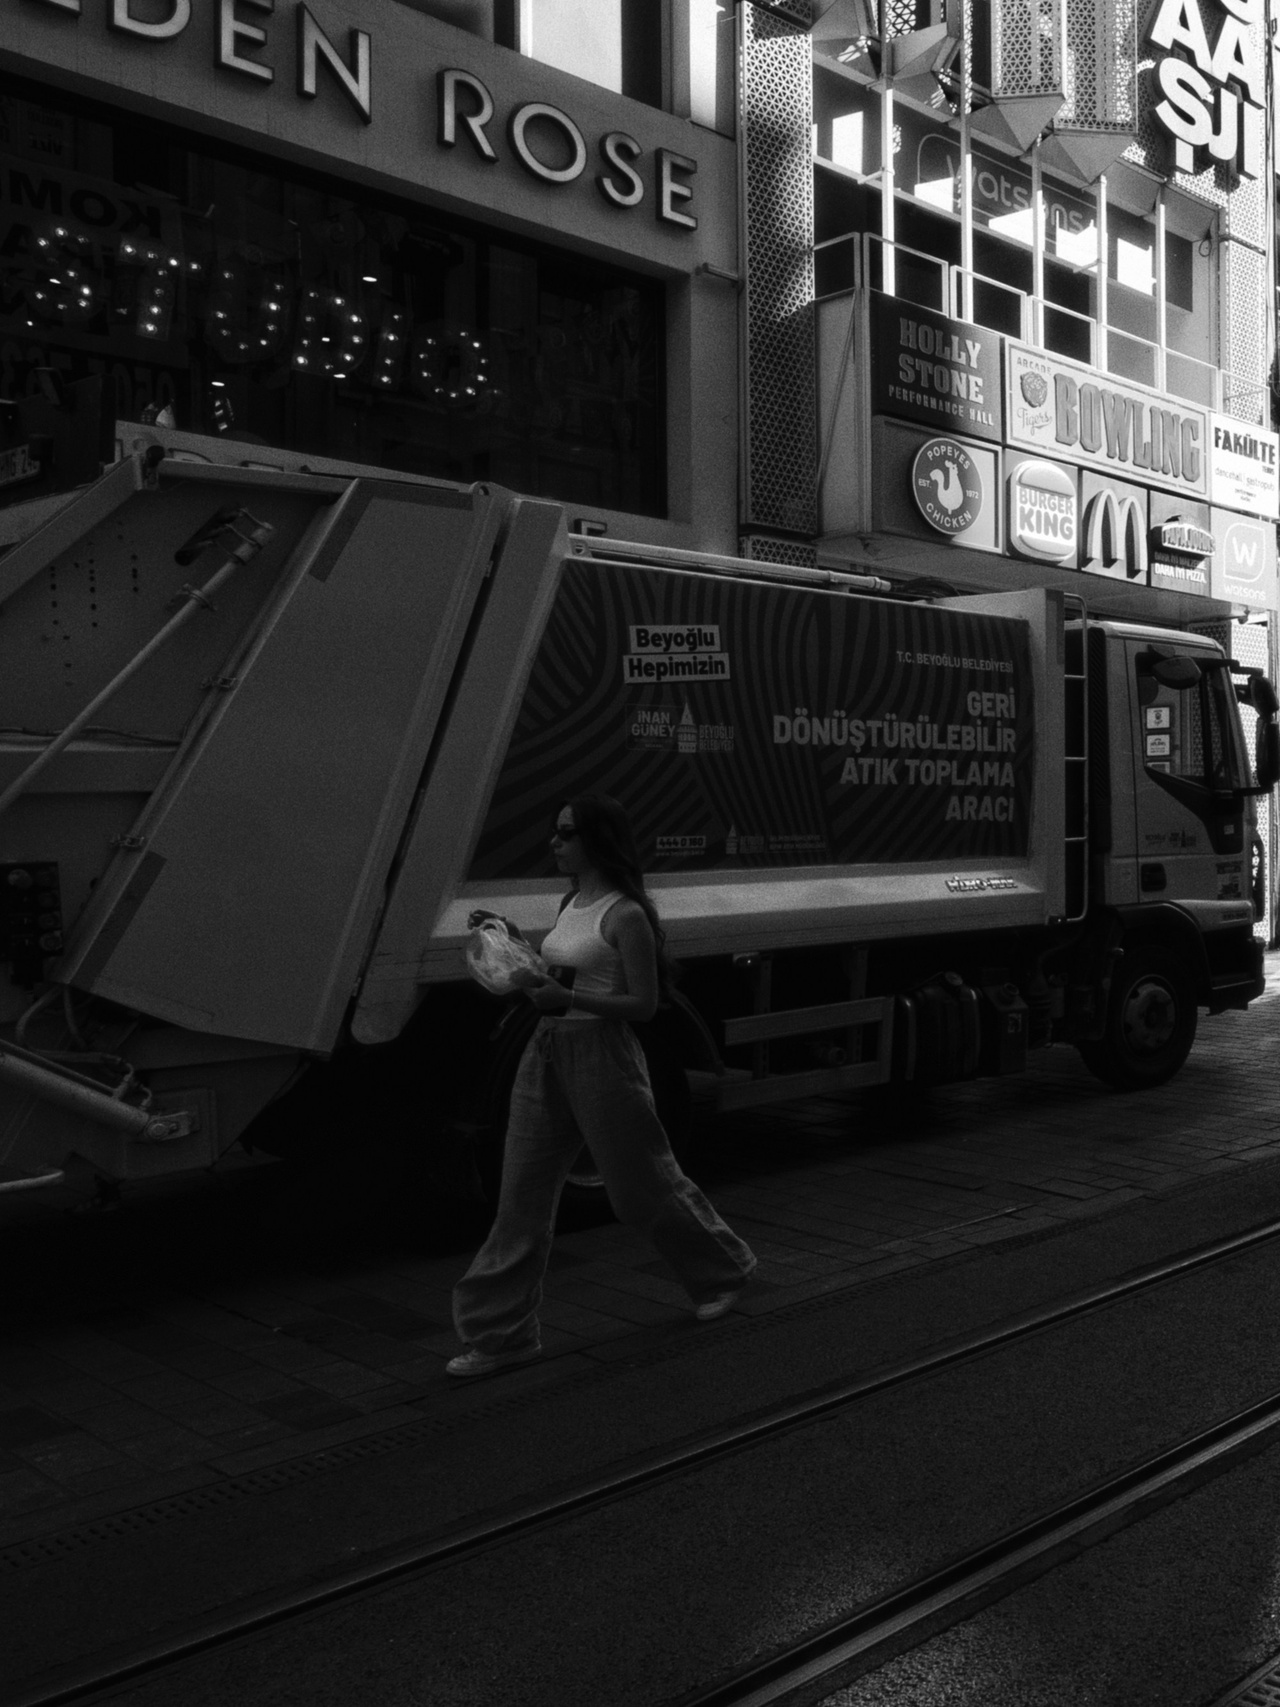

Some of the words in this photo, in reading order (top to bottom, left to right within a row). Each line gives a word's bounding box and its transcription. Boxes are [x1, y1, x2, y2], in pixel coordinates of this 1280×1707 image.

[436, 66, 698, 231] ROSE
[899, 316, 982, 370] HOLLY
[899, 352, 984, 405] STONE
[888, 384, 965, 418] PERFORMANCE
[969, 408, 995, 427] HALL
[1016, 406, 1053, 437] Tigers
[1054, 372, 1201, 483] BOWLING
[927, 445, 971, 470] POPEYES
[1214, 426, 1276, 466] FAKÜLTE
[918, 478, 933, 489] EST.
[965, 489, 980, 500] 1972
[1019, 488, 1074, 516] BURGER
[925, 502, 973, 529] CHICKEN
[1018, 505, 1074, 541] KING
[1223, 583, 1267, 602] watsons
[635, 628, 716, 652] Beyoğlu
[628, 654, 726, 681] Hepimizin
[896, 650, 915, 664] T.C.
[916, 652, 960, 669] BEYOĞLU
[961, 657, 1014, 674] BELEDİYESİ
[966, 686, 1017, 719] GERİ
[631, 723, 676, 738] GÜNEY
[637, 710, 670, 724] İNAN
[773, 706, 1017, 754] DÖNÜŞTÜRÜLEBİLİR
[839, 756, 900, 786] ATIK
[904, 758, 1016, 788] TOPLAMA
[945, 795, 1015, 823] ARACI
[658, 836, 679, 848] 444
